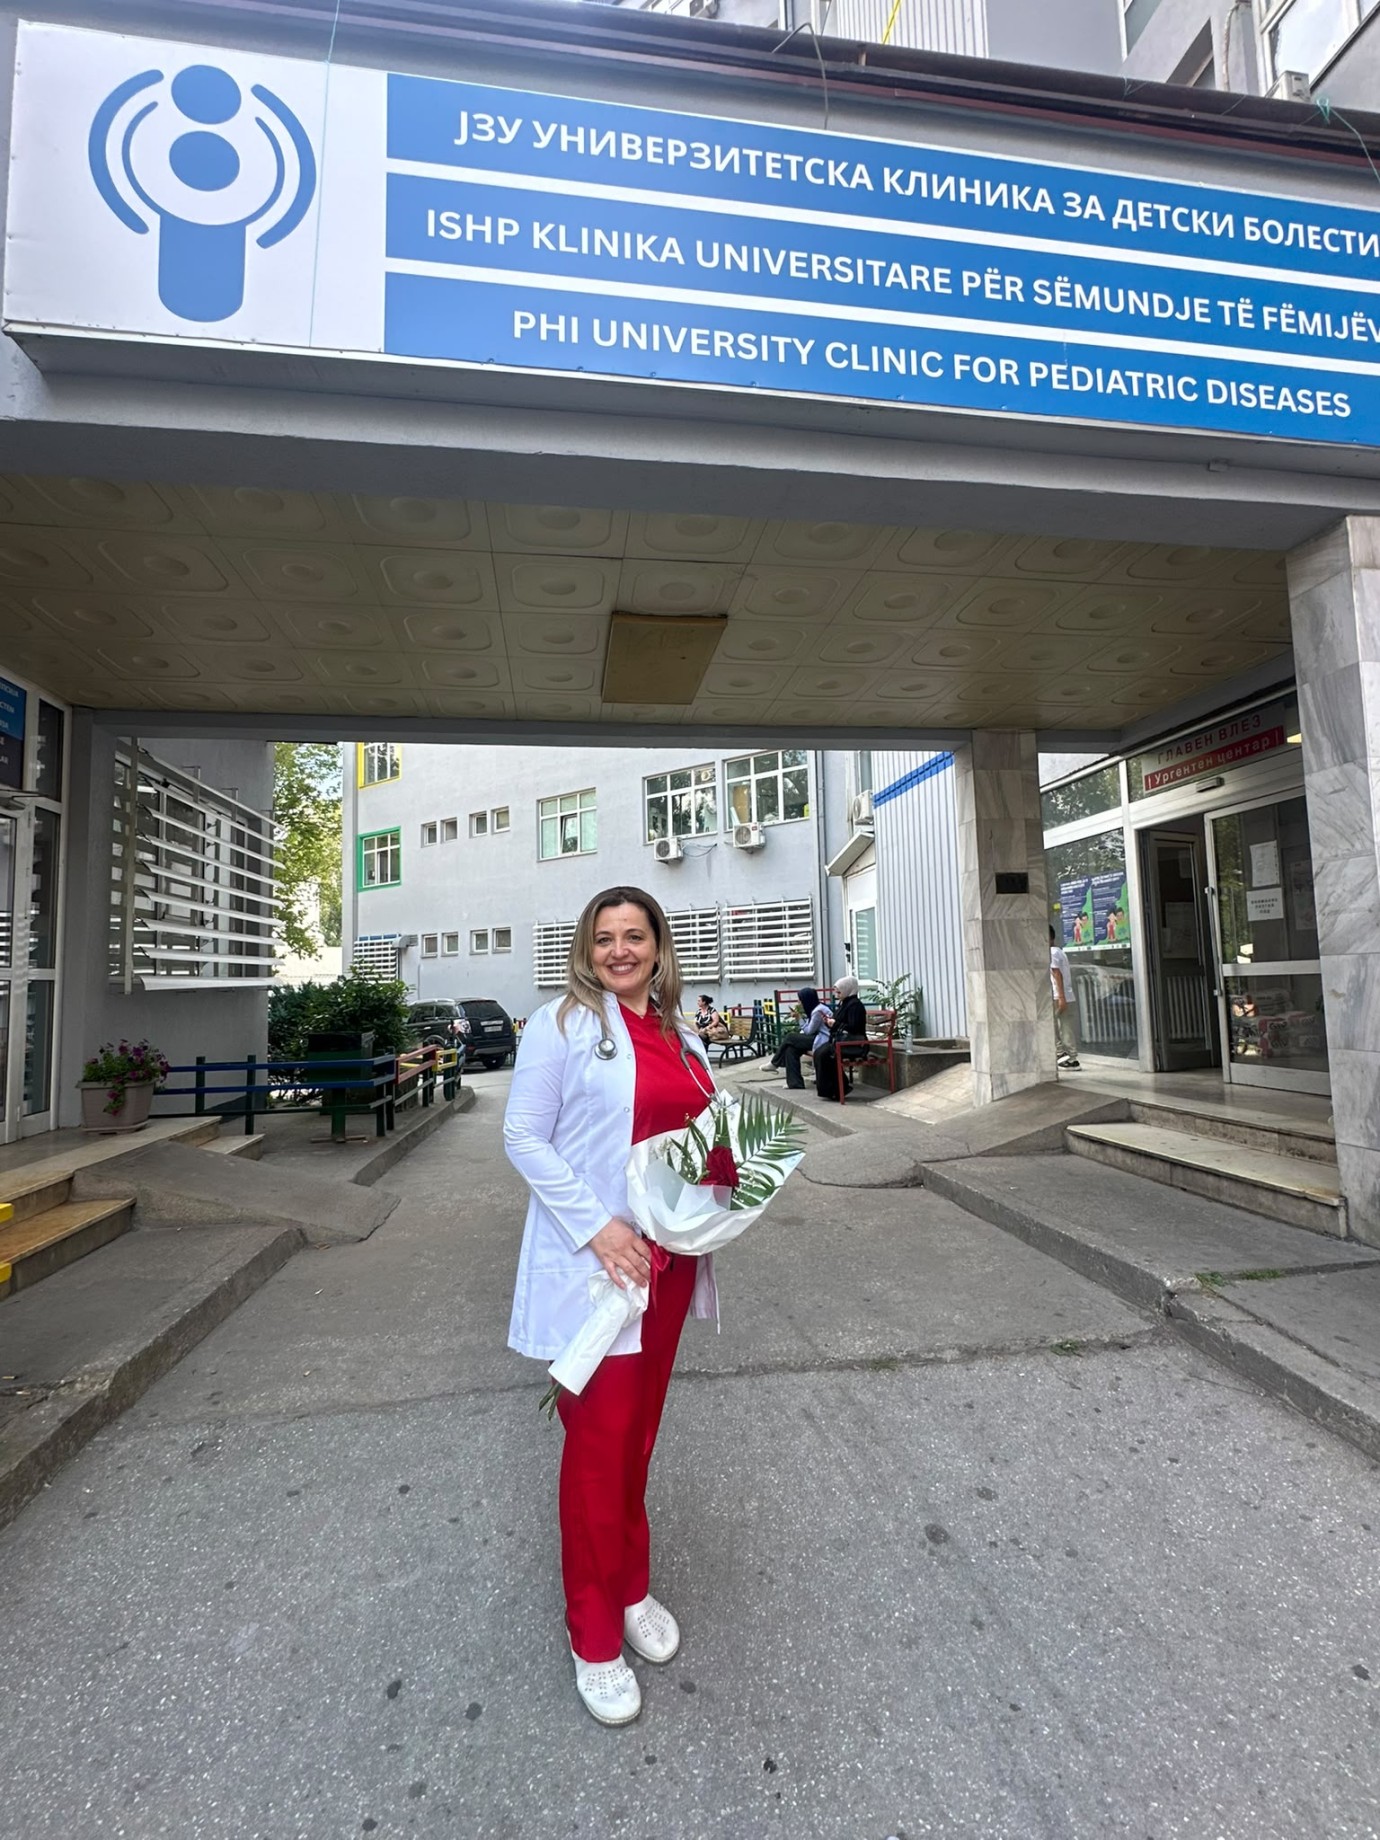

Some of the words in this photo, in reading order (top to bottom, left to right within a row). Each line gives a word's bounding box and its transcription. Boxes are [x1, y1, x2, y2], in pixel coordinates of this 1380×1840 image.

[453, 110, 523, 147] ЈЗУ
[532, 119, 874, 191] УНИВЕРЗИТЕТСКА
[883, 166, 1055, 215] КЛИНИКА
[1064, 191, 1105, 222] ЗА
[1111, 198, 1235, 239] ДЕТСКИ
[1243, 216, 1380, 258] БОЛЕСТИ
[426, 208, 520, 246] ISHP
[532, 220, 686, 266] KLINIKA
[695, 239, 952, 295] UNIVERSITARE
[962, 268, 1025, 303] PËR
[1033, 276, 1212, 325] SËMUNDJE
[1218, 297, 1255, 330] TË
[513, 309, 580, 345] PHI
[592, 318, 815, 365] UNIVERSITY
[824, 341, 944, 379] CLINIC
[953, 353, 1020, 386] FOR
[1029, 361, 1198, 403] PEDIATRIC
[1206, 379, 1351, 419] DISEASES
[1155, 757, 1213, 785] Ургентен
[1217, 737, 1270, 766] центар
[1157, 734, 1214, 765] ГЛАВЕН
[1218, 714, 1262, 741] ВЛЕЗ
